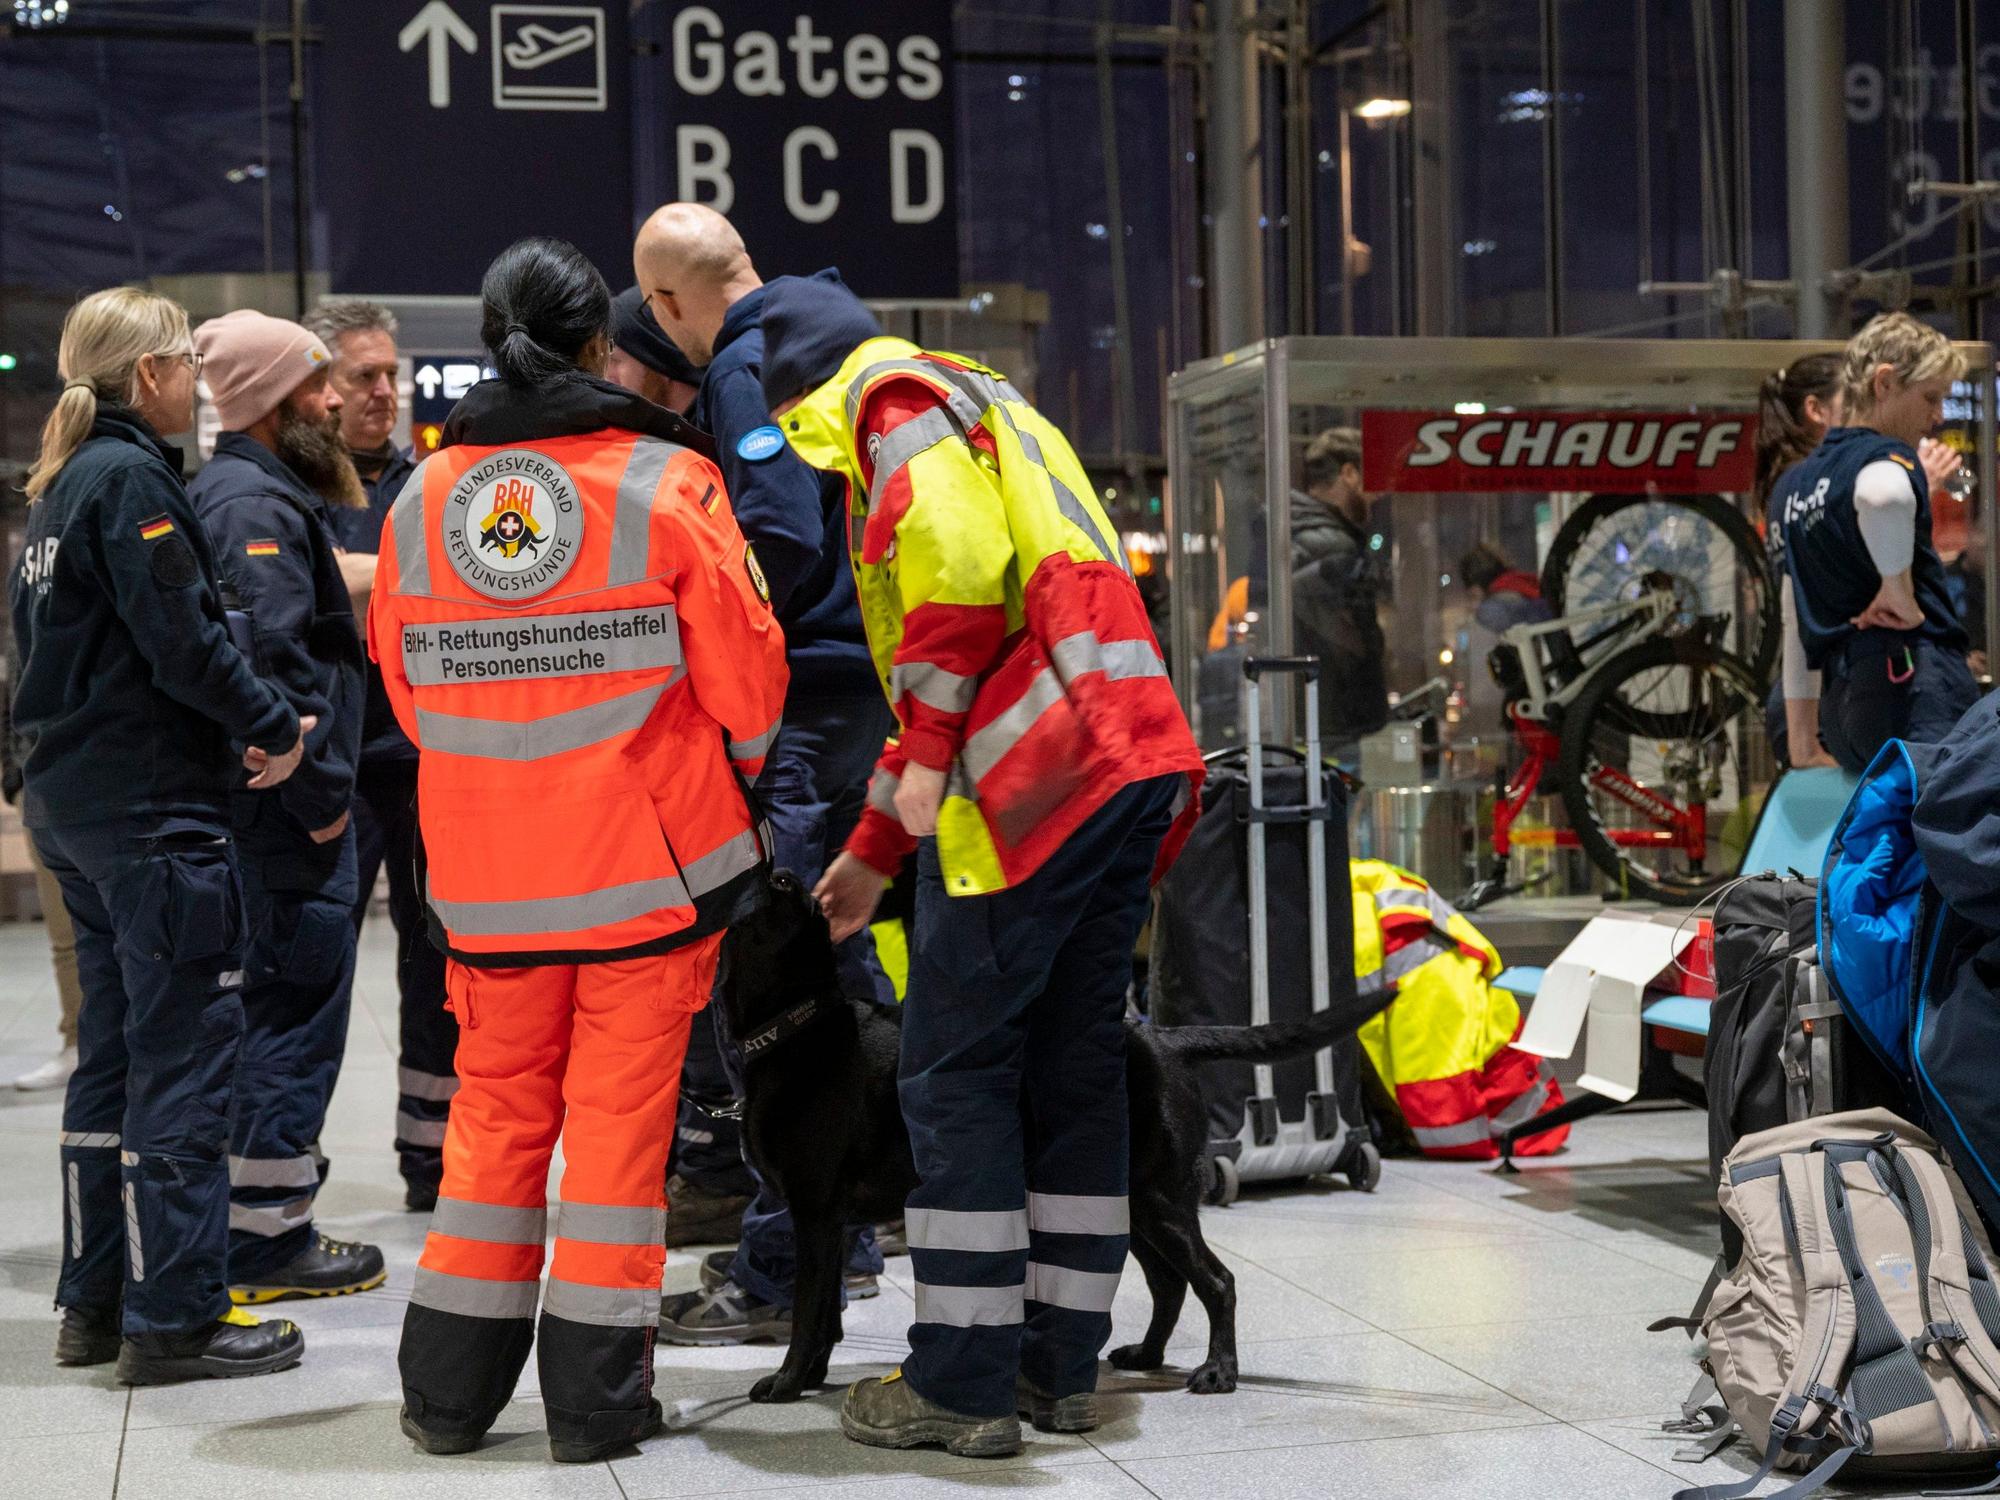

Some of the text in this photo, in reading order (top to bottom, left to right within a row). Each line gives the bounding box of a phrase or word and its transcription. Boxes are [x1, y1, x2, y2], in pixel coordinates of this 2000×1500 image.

[672, 5, 943, 100] Gates
[676, 124, 945, 224] B C D
[1408, 420, 1743, 468] SCHAUFF
[454, 457, 573, 513] BUNDESVERBAND
[493, 479, 535, 516] BRH
[450, 529, 572, 591] RETTUNGSHUNDE
[438, 613, 667, 652] Rettungshundestaffel
[441, 649, 605, 679] Personensuche
[744, 1026, 778, 1053] Ally
